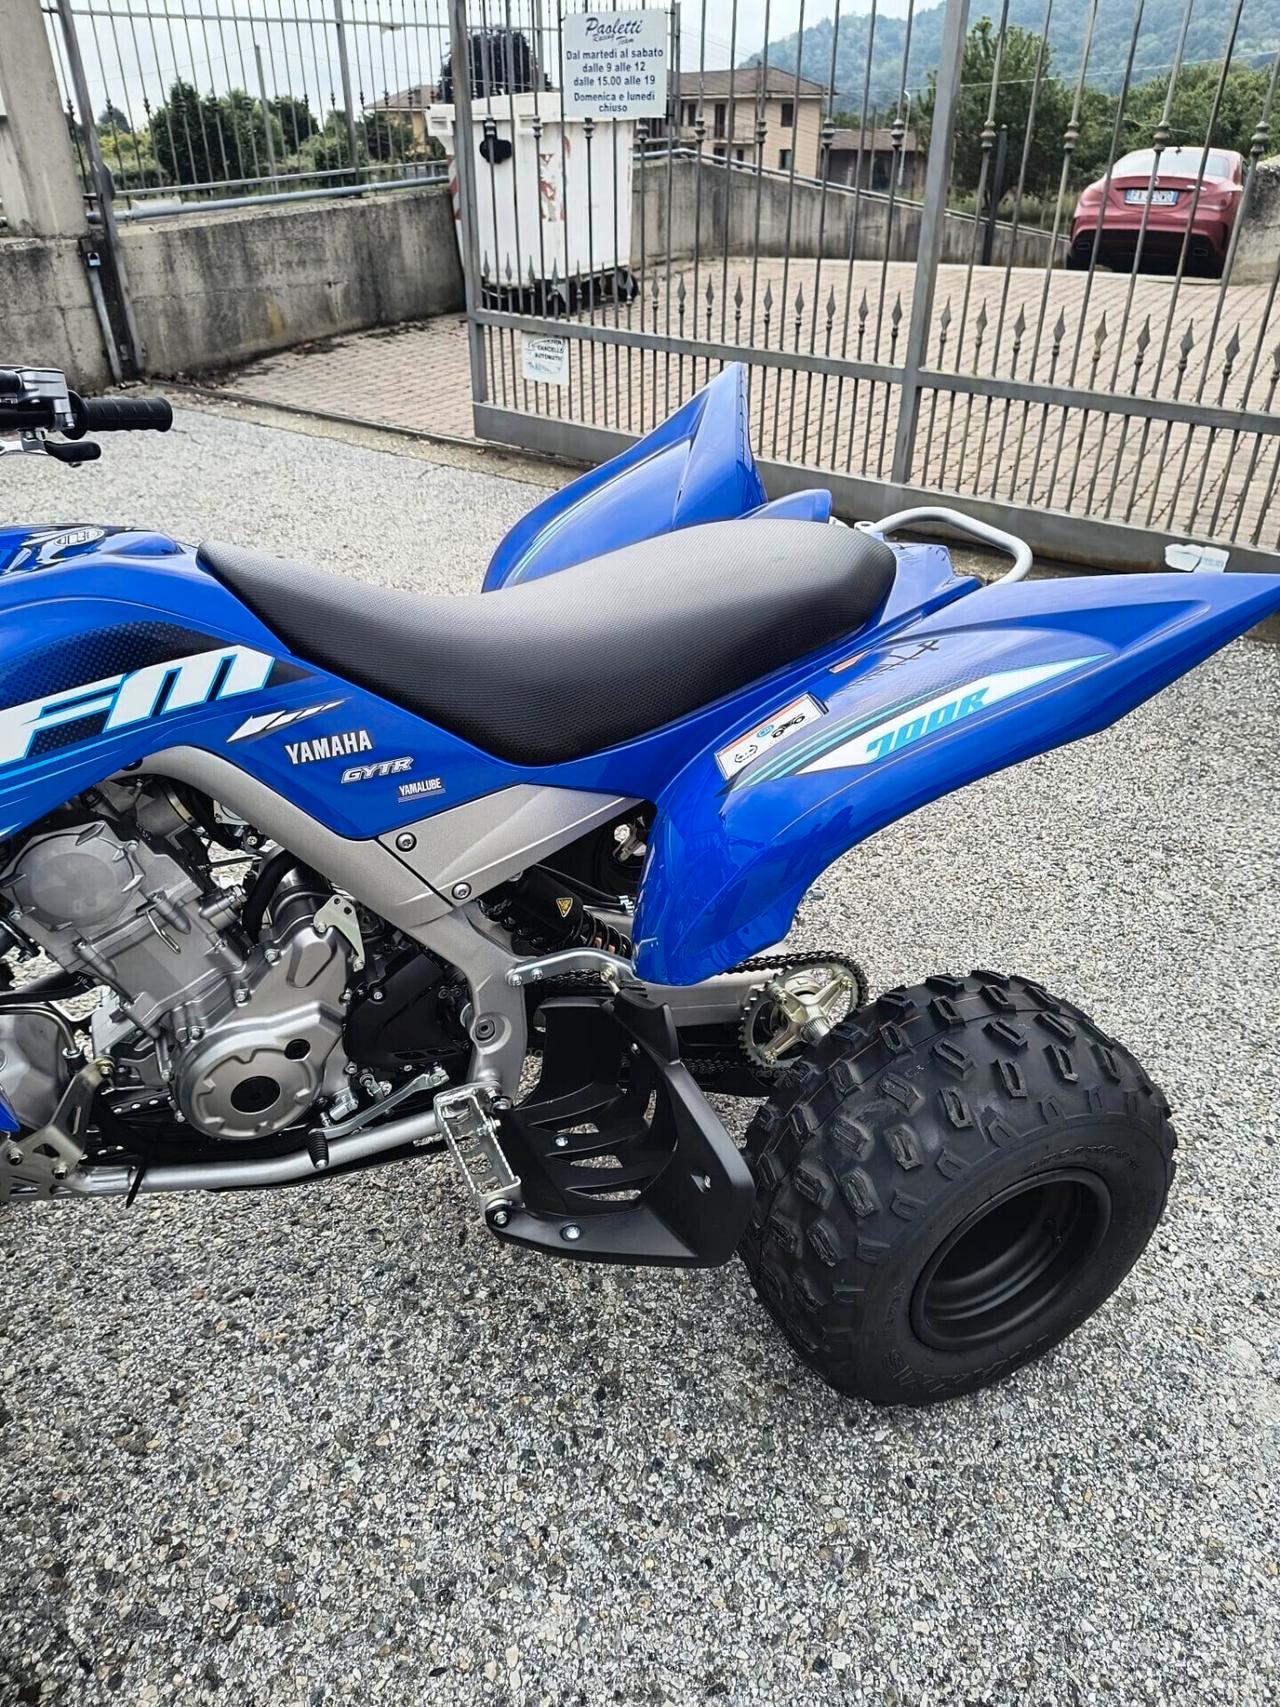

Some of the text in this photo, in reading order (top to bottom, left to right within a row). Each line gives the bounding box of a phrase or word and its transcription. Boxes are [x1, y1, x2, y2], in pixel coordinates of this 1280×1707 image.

[585, 17, 643, 36] Paoletti
[566, 50, 580, 60] Dal
[620, 48, 629, 59] al
[631, 47, 663, 58] sabato
[582, 61, 646, 73] dalle 9 alle 12
[573, 75, 656, 86] dalle 15.00 alle 19
[574, 92, 616, 102] Domenica
[598, 103, 628, 112] chiuso
[866, 687, 990, 759] 700R
[285, 730, 373, 765] YAMAHA
[341, 756, 414, 784] GYTR
[399, 777, 443, 797] YAMALUBE
